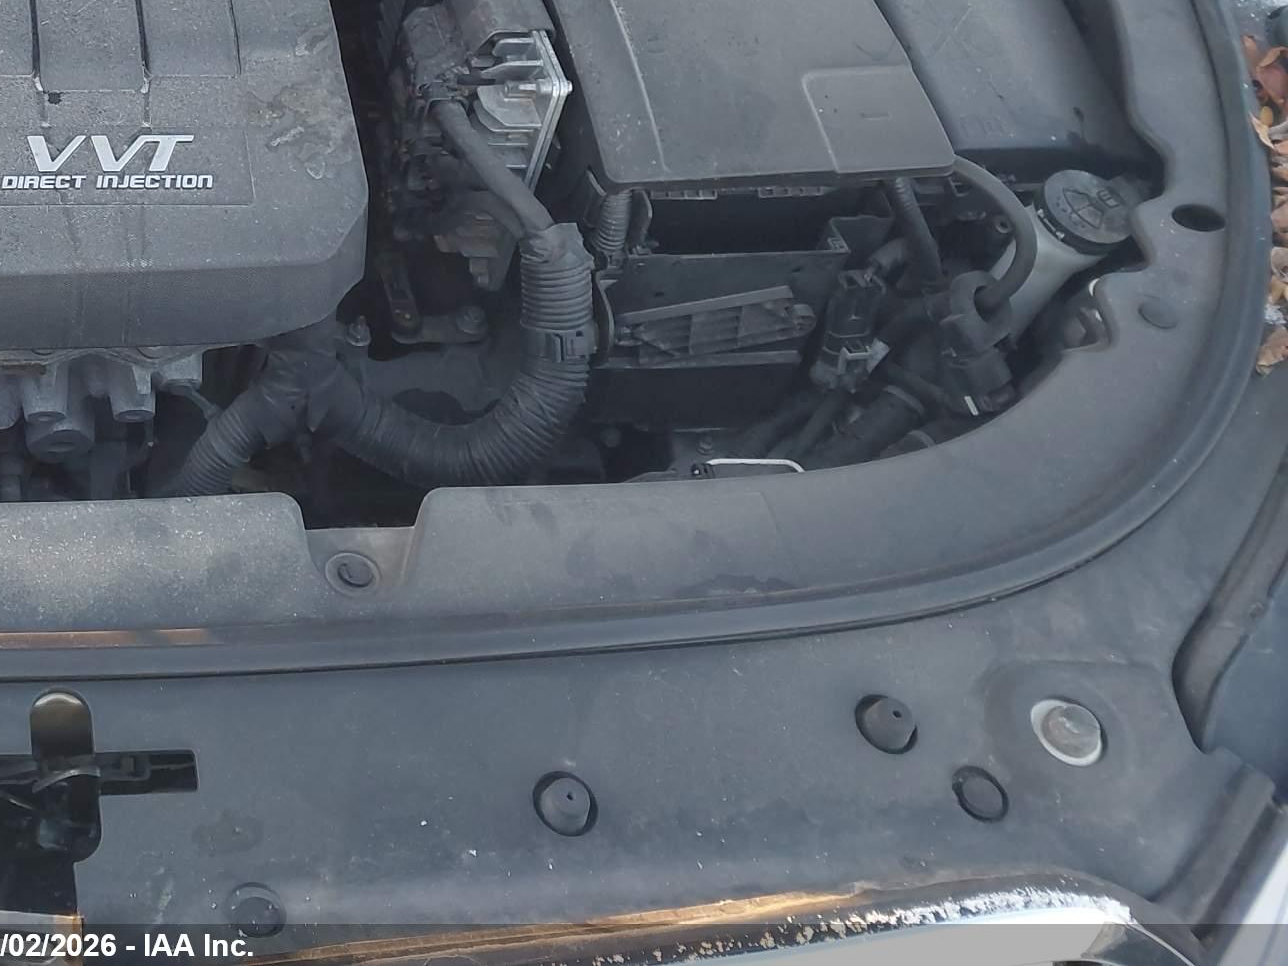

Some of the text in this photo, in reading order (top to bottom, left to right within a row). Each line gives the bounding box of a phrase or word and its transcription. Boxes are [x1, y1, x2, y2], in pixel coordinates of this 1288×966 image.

[27, 135, 194, 172] VVT
[1, 174, 213, 189] DIRECT INJECTION
